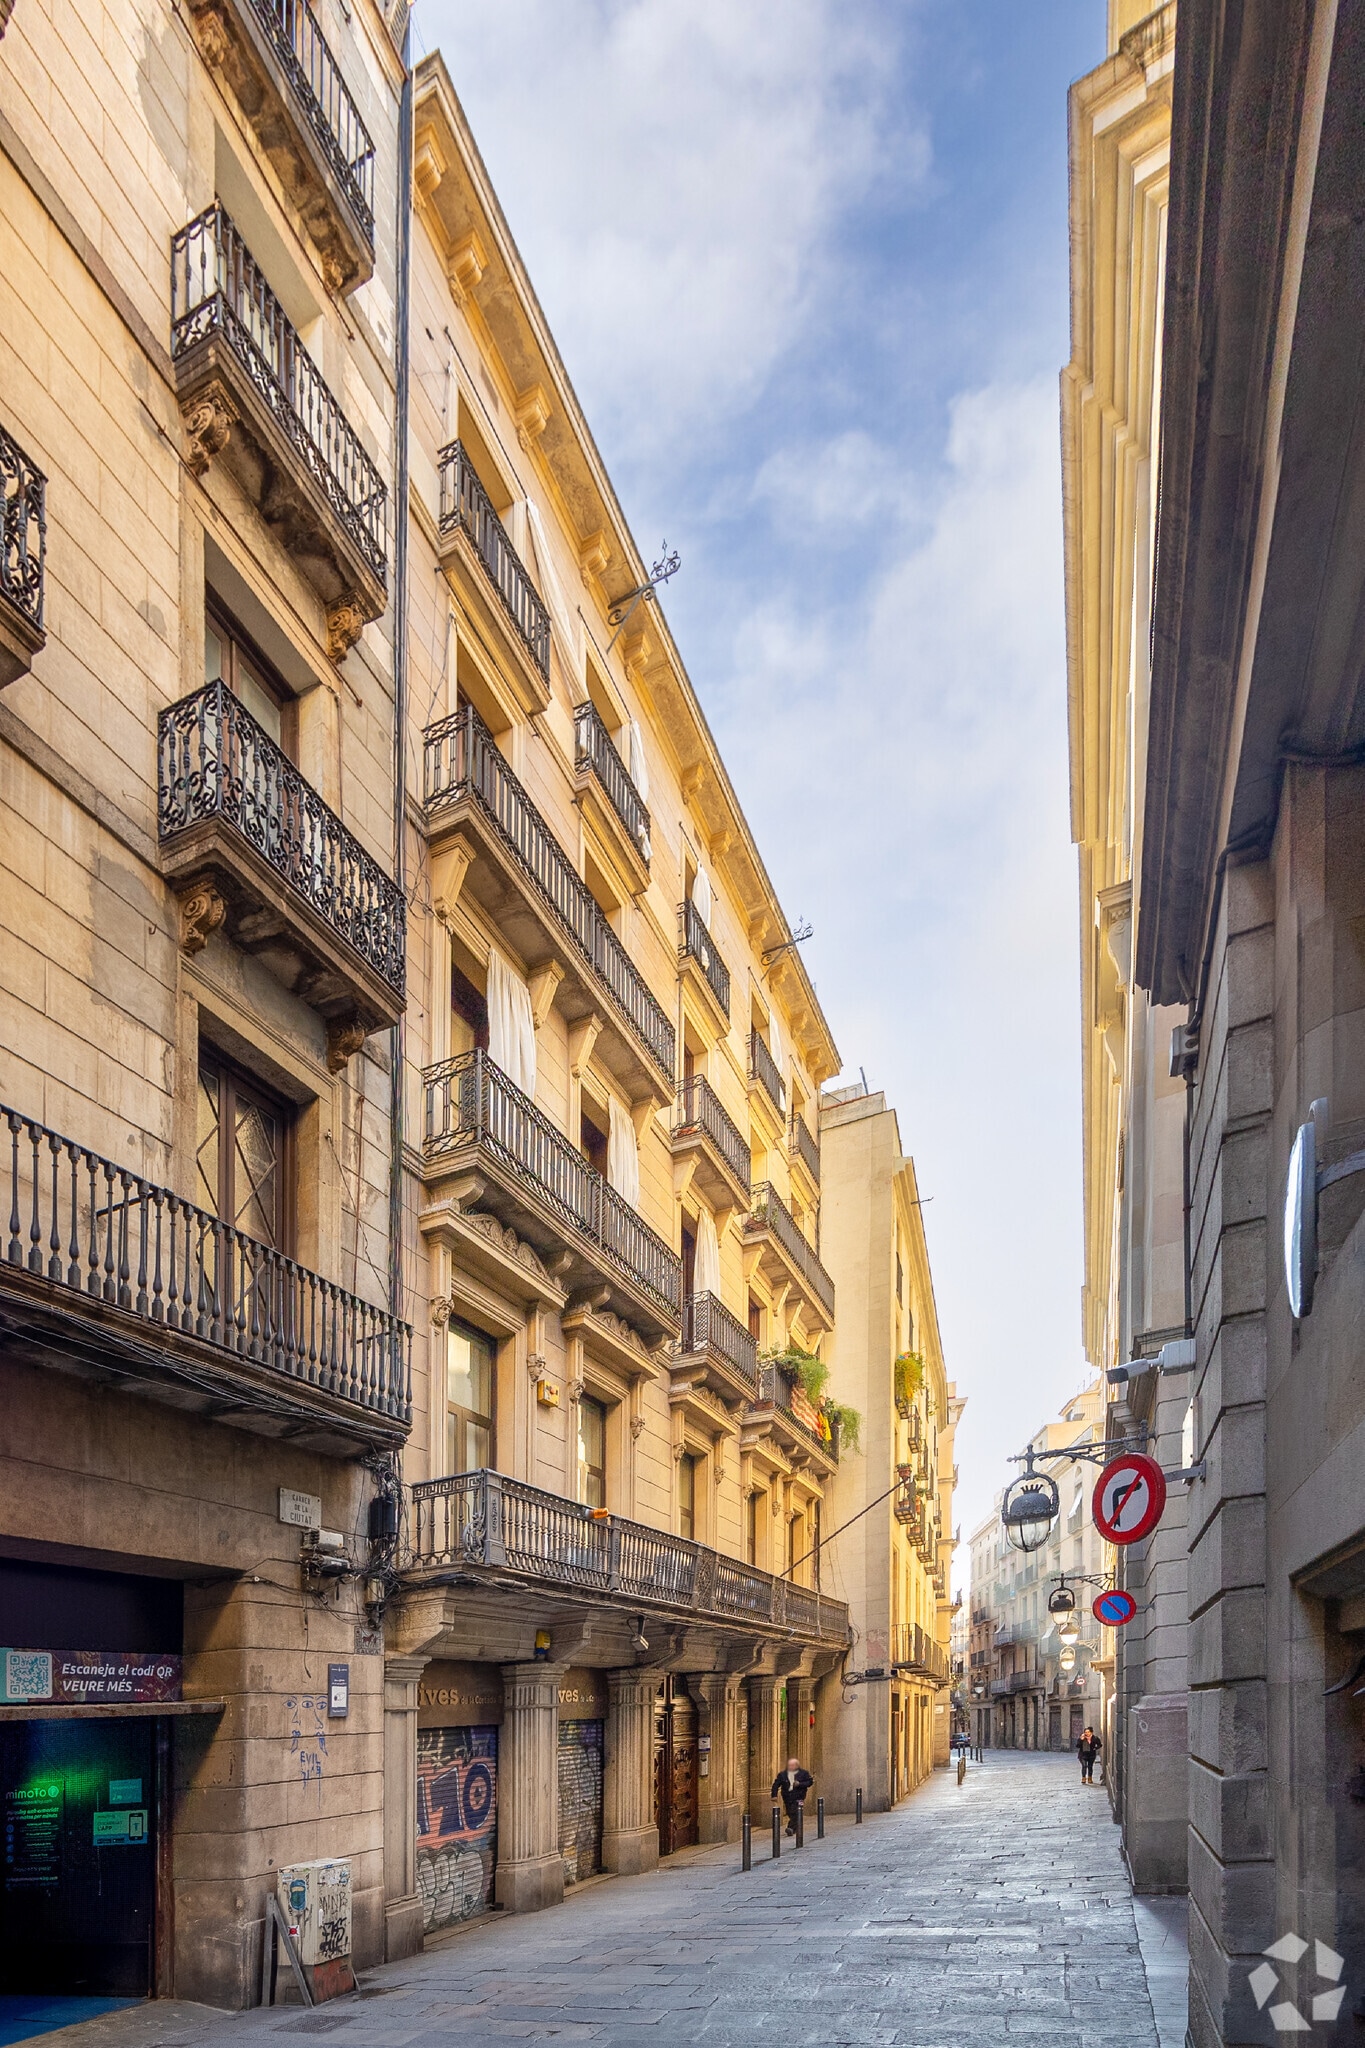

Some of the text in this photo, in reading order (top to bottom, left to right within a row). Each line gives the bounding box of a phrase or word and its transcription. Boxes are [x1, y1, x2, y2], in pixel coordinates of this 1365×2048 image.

[292, 1494, 311, 1505] CARRER
[294, 1503, 309, 1513] DE LA
[290, 1512, 312, 1525] CIUTAT
[62, 1663, 173, 1680] Escaneja el codi QR
[62, 1681, 104, 1692] VEURE
[106, 1678, 133, 1693] MÉS
[419, 1682, 460, 1706] ives
[558, 1689, 579, 1704] ves
[300, 1750, 320, 1765] EVIL
